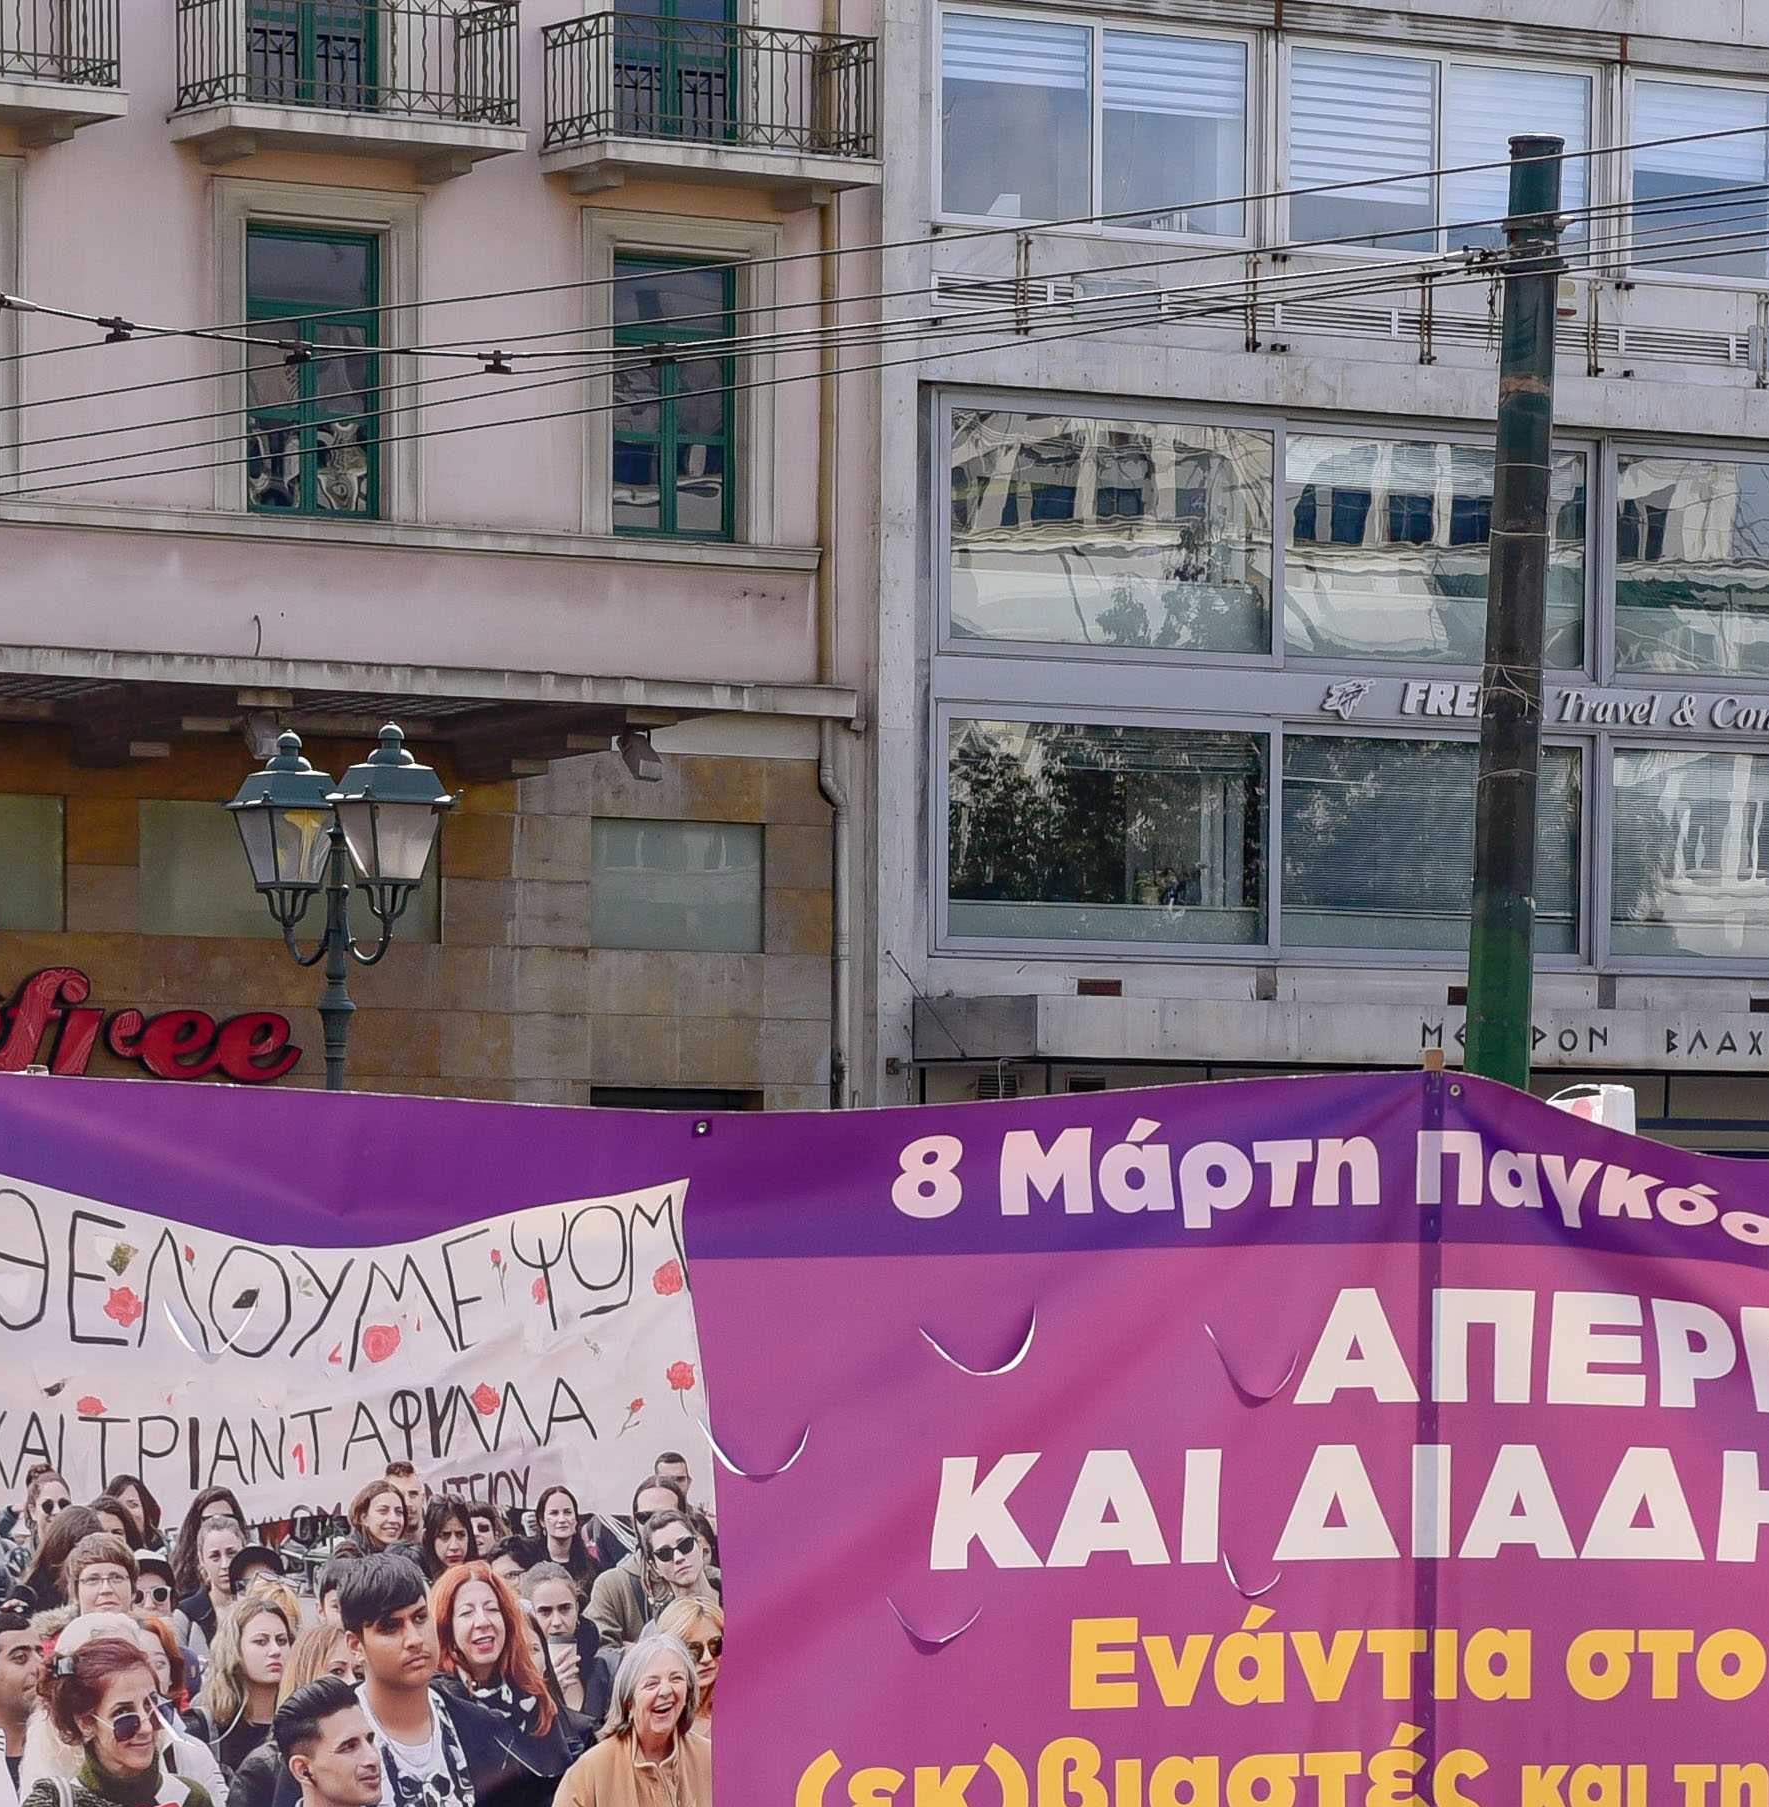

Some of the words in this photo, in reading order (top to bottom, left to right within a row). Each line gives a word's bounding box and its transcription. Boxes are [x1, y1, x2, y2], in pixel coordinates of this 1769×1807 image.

[1557, 689, 1663, 728] Travel
[1673, 692, 1698, 728] &
[891, 1136, 964, 1219] 8
[999, 1117, 1381, 1230] Μάρτη
[928, 1450, 1223, 1571] ΚΑΙ
[1069, 1604, 1533, 1711] Ενάντια
